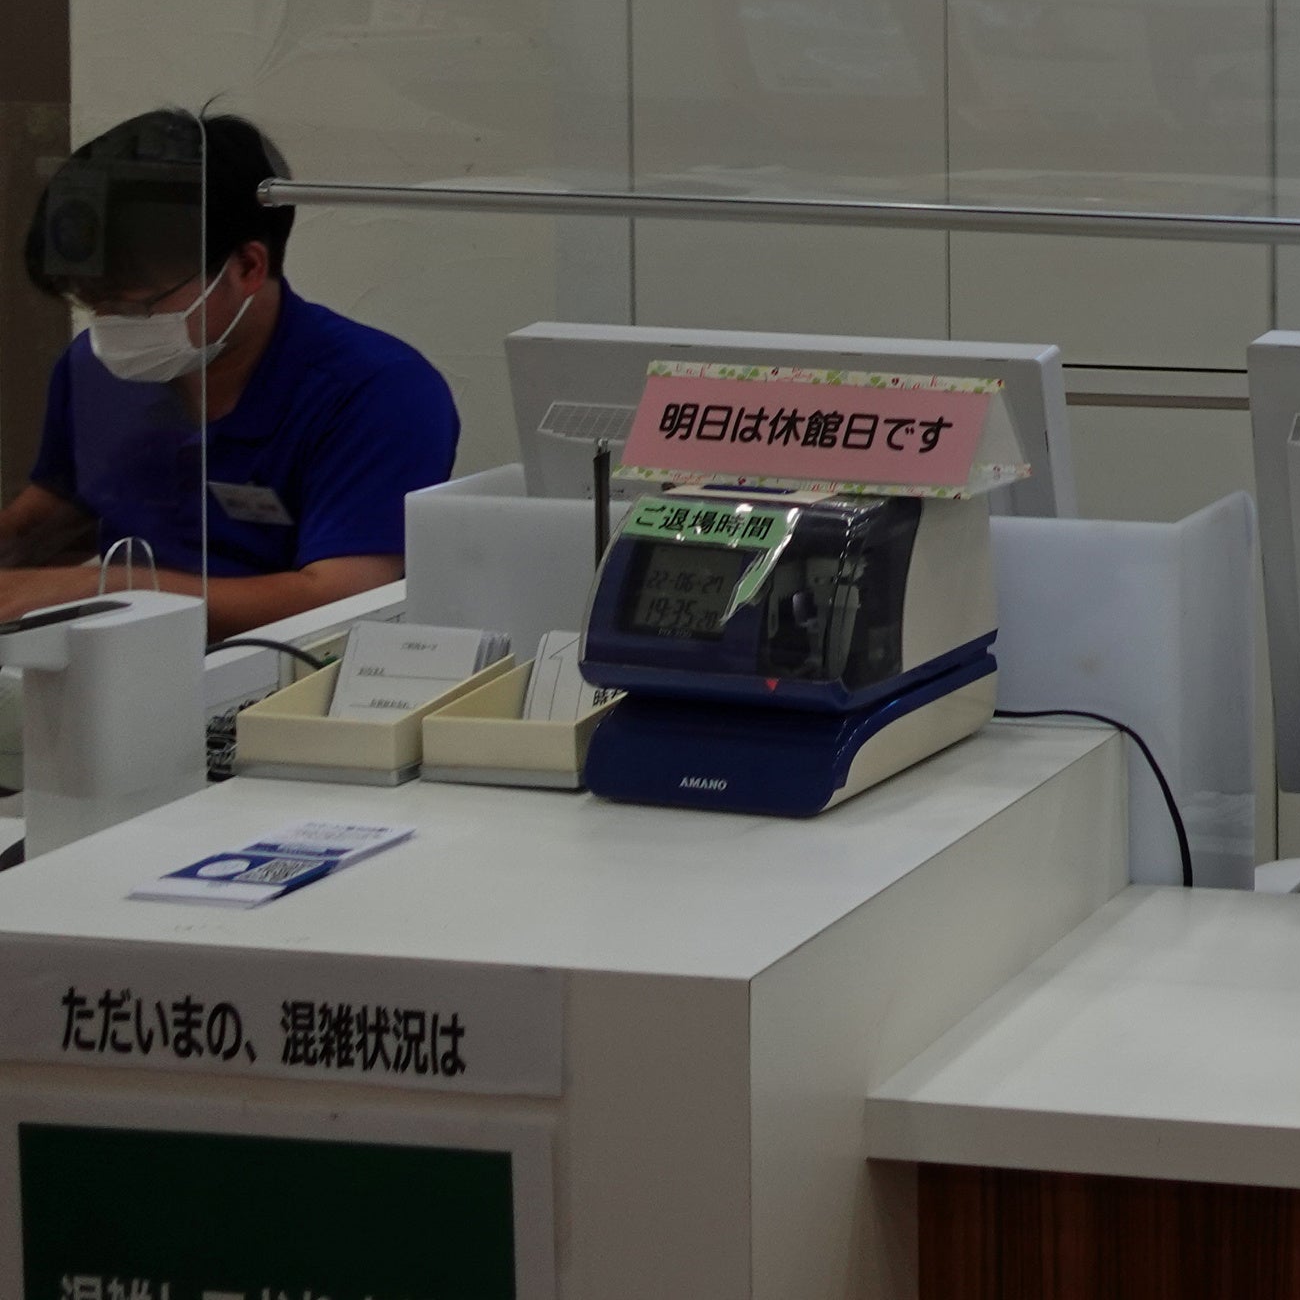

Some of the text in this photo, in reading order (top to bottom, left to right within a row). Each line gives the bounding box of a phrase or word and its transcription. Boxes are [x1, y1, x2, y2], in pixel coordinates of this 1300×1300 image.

[658, 402, 953, 453] 明日は休館日です
[635, 505, 776, 541] ご退場時間
[678, 776, 728, 791] AMANO
